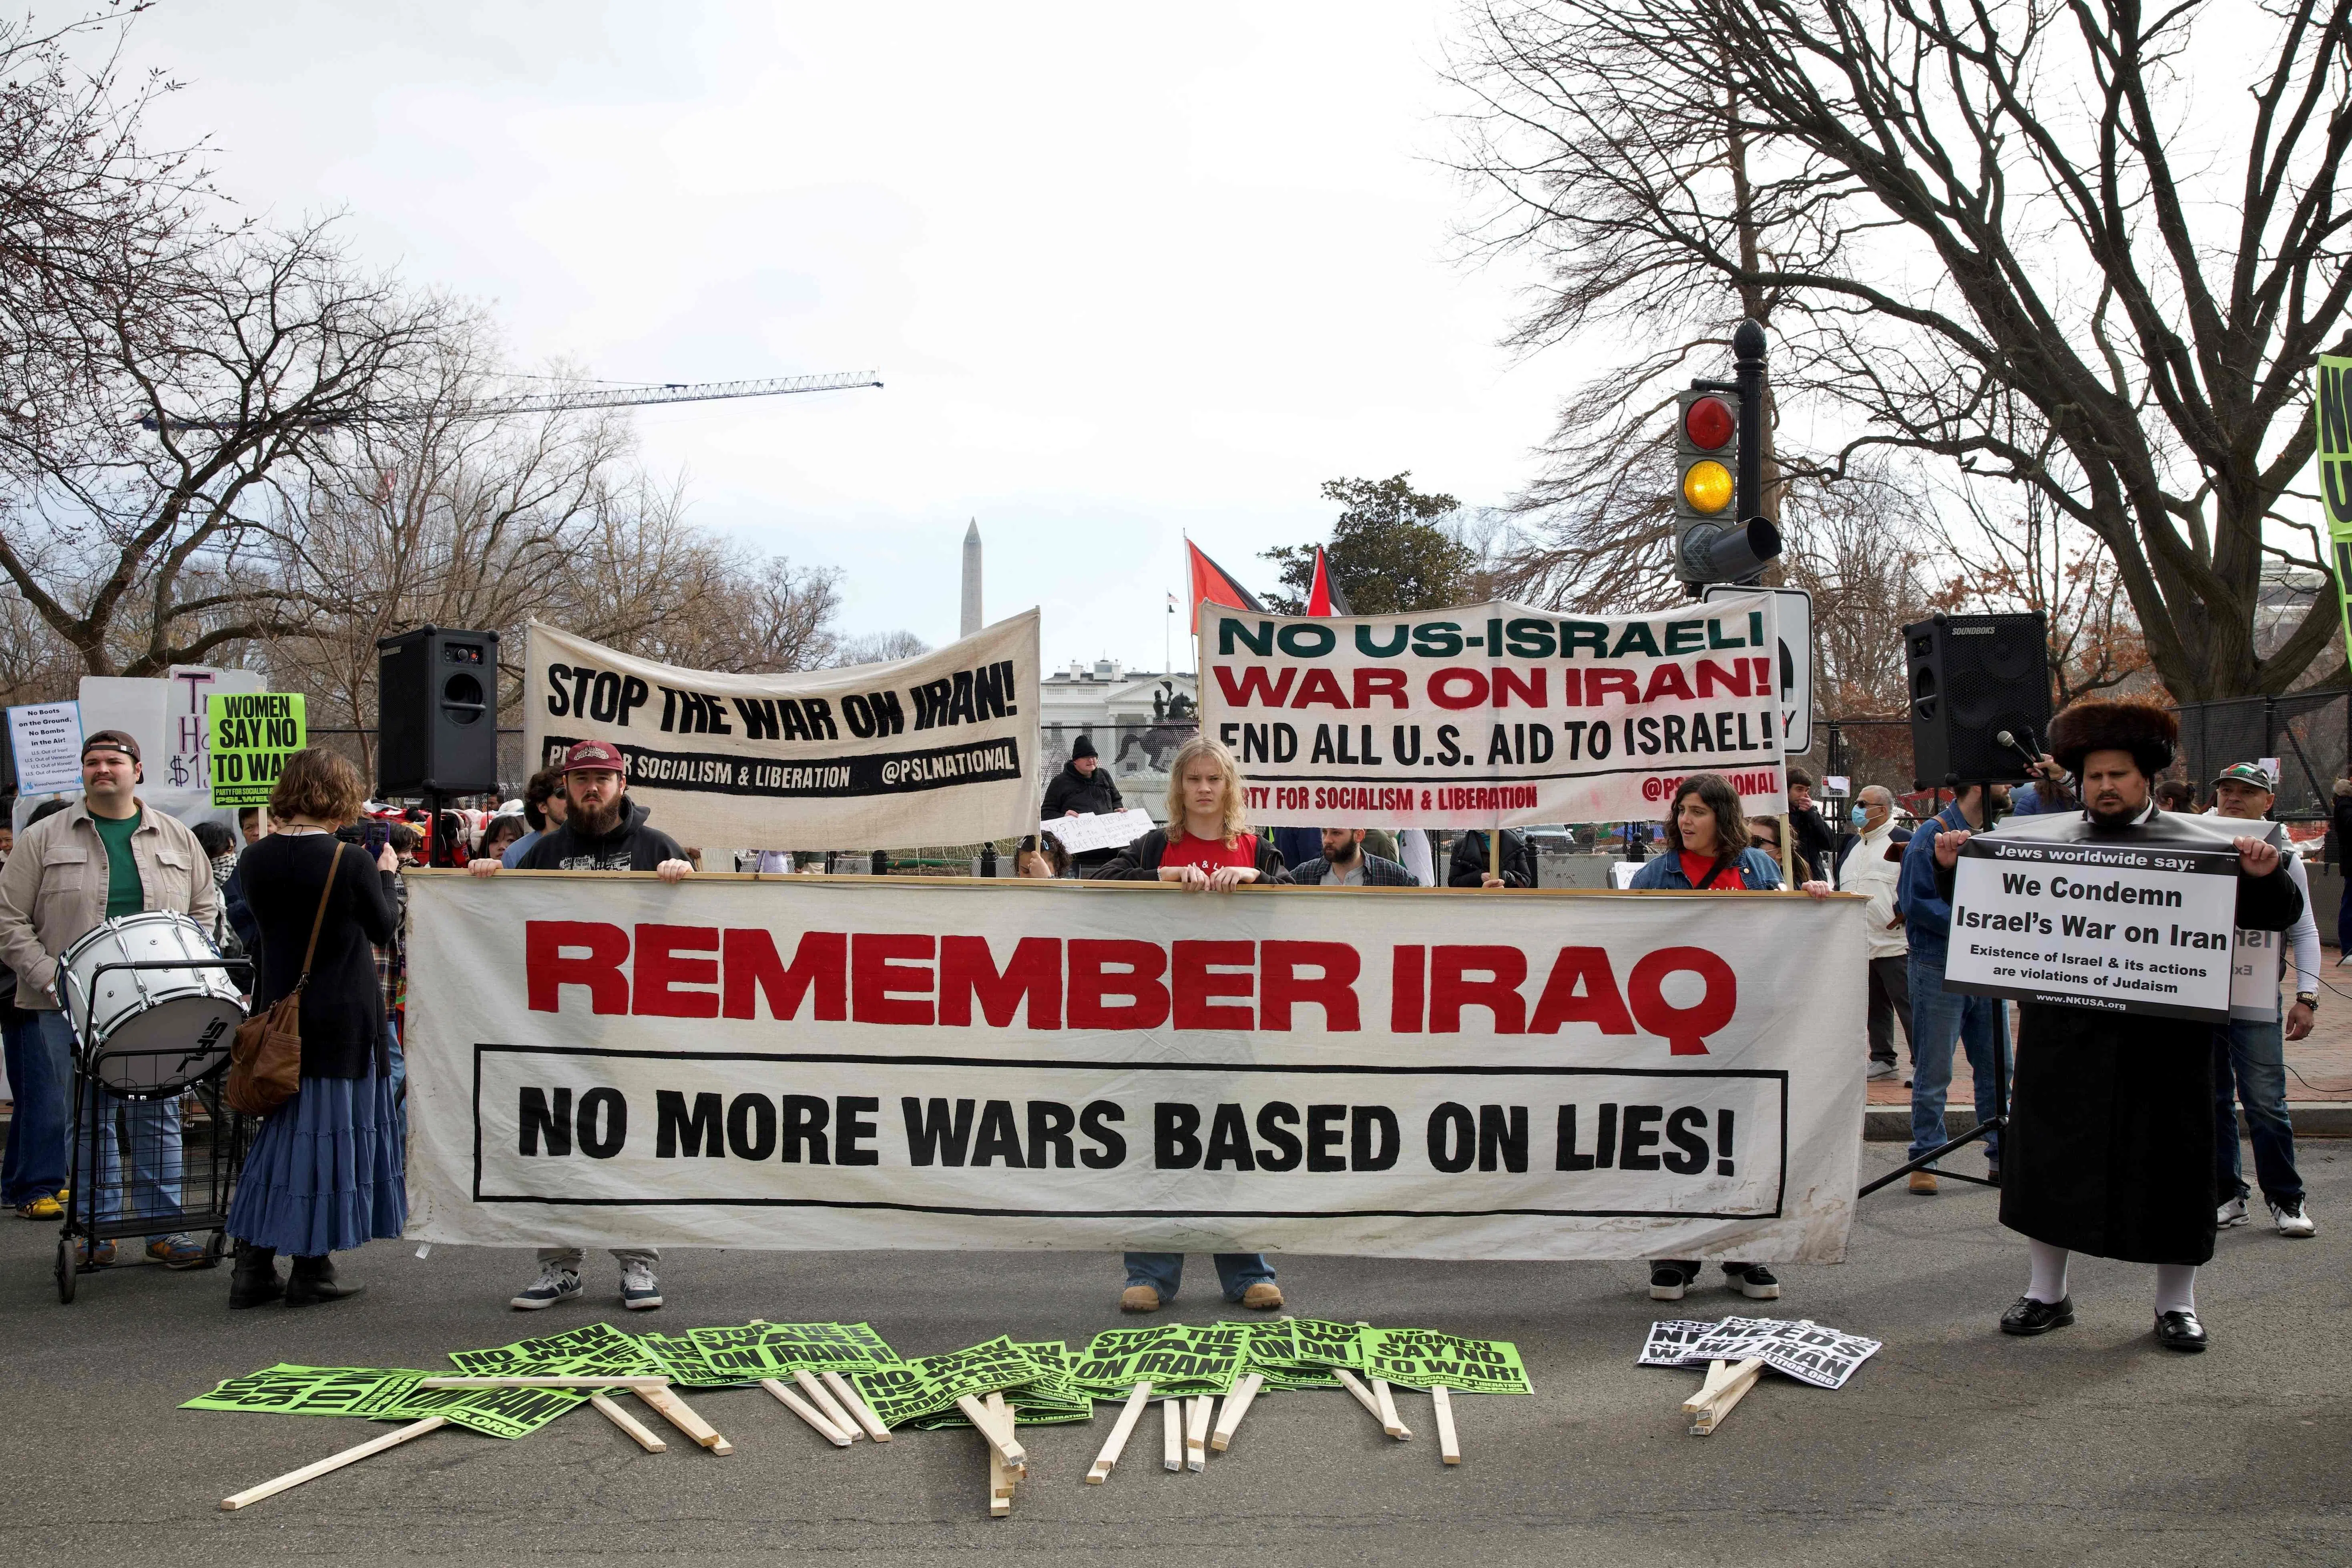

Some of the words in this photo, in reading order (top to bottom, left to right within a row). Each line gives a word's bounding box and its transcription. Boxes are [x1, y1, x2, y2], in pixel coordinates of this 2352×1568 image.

[2321, 365, 2352, 454] N
[1219, 618, 1336, 658] NO
[1355, 612, 1763, 659] US-ISRAELI
[1952, 626, 1995, 635] SOUNDBOKS
[1213, 666, 1409, 709] WAR
[1427, 667, 1547, 710] ON
[1566, 658, 1771, 707] IRAN!
[224, 696, 290, 719] WOMEN
[548, 663, 648, 725] STOP
[657, 685, 731, 735] THE
[731, 698, 838, 741] WAR
[841, 691, 904, 738] ON
[910, 660, 1017, 731] IRAN!
[219, 719, 263, 748] SAY
[267, 718, 297, 747] NO
[1220, 723, 1298, 763] END
[1310, 724, 1382, 765] ALL
[1393, 725, 1474, 766] U.S.
[1488, 723, 1553, 765] AID
[1565, 721, 1611, 761] TO
[1625, 712, 1773, 755] ISRAEL!
[214, 754, 243, 782] TO
[247, 753, 295, 781] WA
[638, 755, 731, 784] SOCIALISM
[738, 766, 749, 785] &
[756, 764, 851, 789] LIBERATION
[882, 746, 1015, 784] @PSLNATIONAL
[1277, 786, 1309, 809] FOR
[1316, 787, 1414, 810] SOCIALISM
[1421, 790, 1432, 810] &
[1438, 786, 1537, 810] LIBERATION
[1049, 823, 1066, 833] US
[1202, 860, 1209, 868] &
[1995, 845, 2043, 859] Jews
[2049, 850, 2148, 867] worldwide
[2153, 856, 2195, 872] say:
[2002, 873, 2041, 896] We
[2050, 876, 2182, 907] Condemn
[1956, 905, 2052, 934] Israel’s
[2062, 914, 2116, 940] War
[2124, 925, 2159, 944] on
[2170, 924, 2227, 951] Iran
[1970, 944, 2040, 961] Existence
[2044, 952, 2058, 962] of
[2062, 953, 2103, 967] Israel
[2107, 958, 2119, 968] &
[2124, 959, 2144, 971] its
[2149, 962, 2207, 977] actions
[525, 920, 1361, 1032] REMEMBER
[1392, 945, 1737, 1056] IRAQ
[1992, 966, 2016, 976] are
[2021, 968, 2089, 984] violations
[2093, 975, 2109, 985] of
[2112, 976, 2178, 993] Judaism
[2036, 994, 2126, 1011] www.NKUSA.org
[519, 1086, 627, 1159] NO
[655, 1089, 879, 1166] MORE
[902, 1096, 1126, 1170] WARS
[1154, 1101, 1400, 1172] BASED
[1427, 1101, 1528, 1173] ON
[1555, 1102, 1734, 1177] LIES!
[455, 1350, 515, 1367] NO
[519, 1324, 609, 1353] NEW
[693, 1324, 773, 1341] STOP
[779, 1325, 842, 1335] THE
[699, 1333, 852, 1351] WAR
[1095, 1328, 1178, 1347] STOP
[1187, 1329, 1244, 1344] THE
[1385, 1333, 1492, 1351] WOMEN
[1711, 1326, 1867, 1357] NEEDS
[525, 1335, 624, 1361] WAR
[709, 1348, 767, 1368] ON
[767, 1344, 871, 1365] IRAN!
[1093, 1339, 1239, 1358] WAR
[1300, 1339, 1348, 1360] ON
[1377, 1343, 1446, 1358] SAY
[1454, 1347, 1506, 1364] NO
[1695, 1342, 1755, 1353] W/
[1760, 1342, 1850, 1379] IRAN
[858, 1371, 915, 1389] NO
[921, 1339, 1009, 1371] NEW
[865, 1380, 924, 1398] US
[924, 1350, 1024, 1378] WAR
[1075, 1357, 1131, 1379] ON
[1133, 1353, 1237, 1376] IRAN!
[1246, 1367, 1286, 1382] SOCIALISM
[1368, 1355, 1416, 1373] TO
[1423, 1359, 1522, 1381] WAR!
[1371, 1368, 1397, 1378] PARTY
[1416, 1375, 1461, 1383] SOCIALISM
[873, 1389, 928, 1411] IN
[930, 1361, 1032, 1387] THE
[878, 1379, 974, 1419] MIDDLE
[976, 1369, 1035, 1384] EAST
[1031, 1387, 1076, 1400] LIBERATION
[906, 1409, 931, 1417] PARTY
[934, 1400, 948, 1411] FOR
[949, 1384, 991, 1401] SOCIALISM
[1041, 1413, 1088, 1421] LIBERATION
